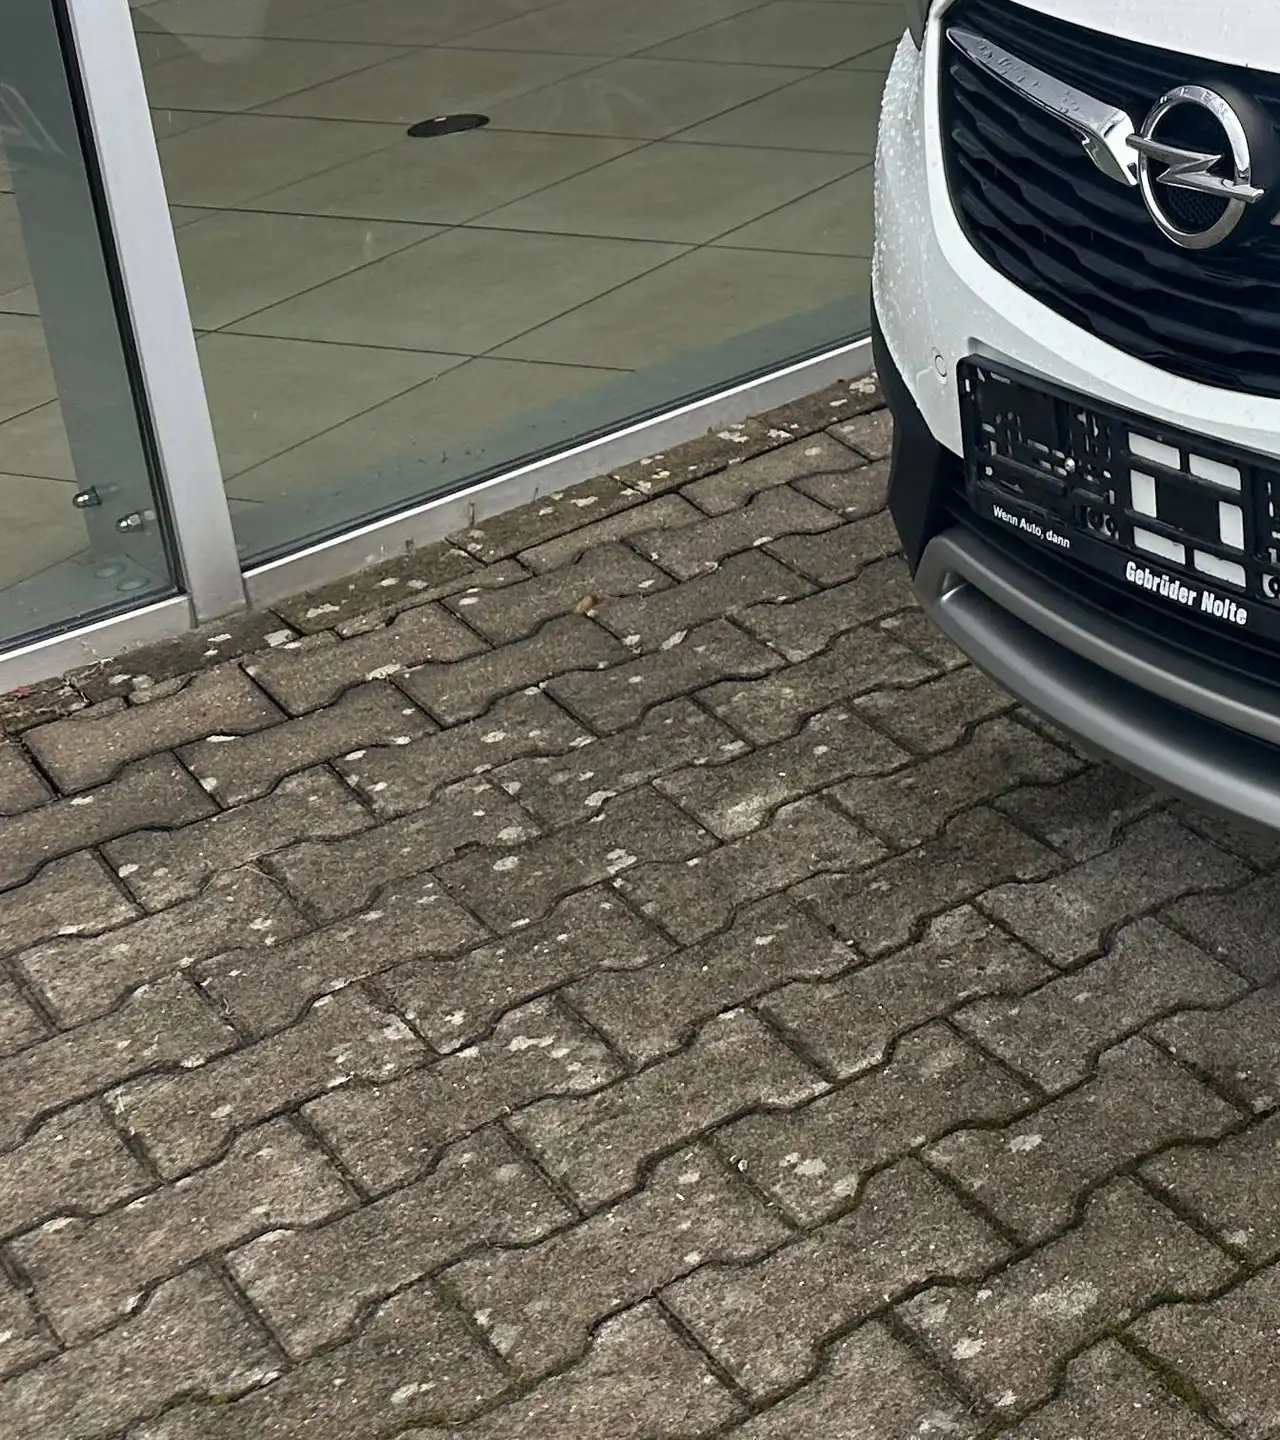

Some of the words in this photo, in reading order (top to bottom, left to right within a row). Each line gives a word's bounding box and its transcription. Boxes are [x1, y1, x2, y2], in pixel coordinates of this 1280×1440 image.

[992, 503, 1019, 528] Wenn
[1019, 517, 1045, 541] Auto,
[1046, 528, 1071, 550] dann
[1125, 560, 1198, 607] Gebrüder
[1200, 590, 1249, 626] Nolte
